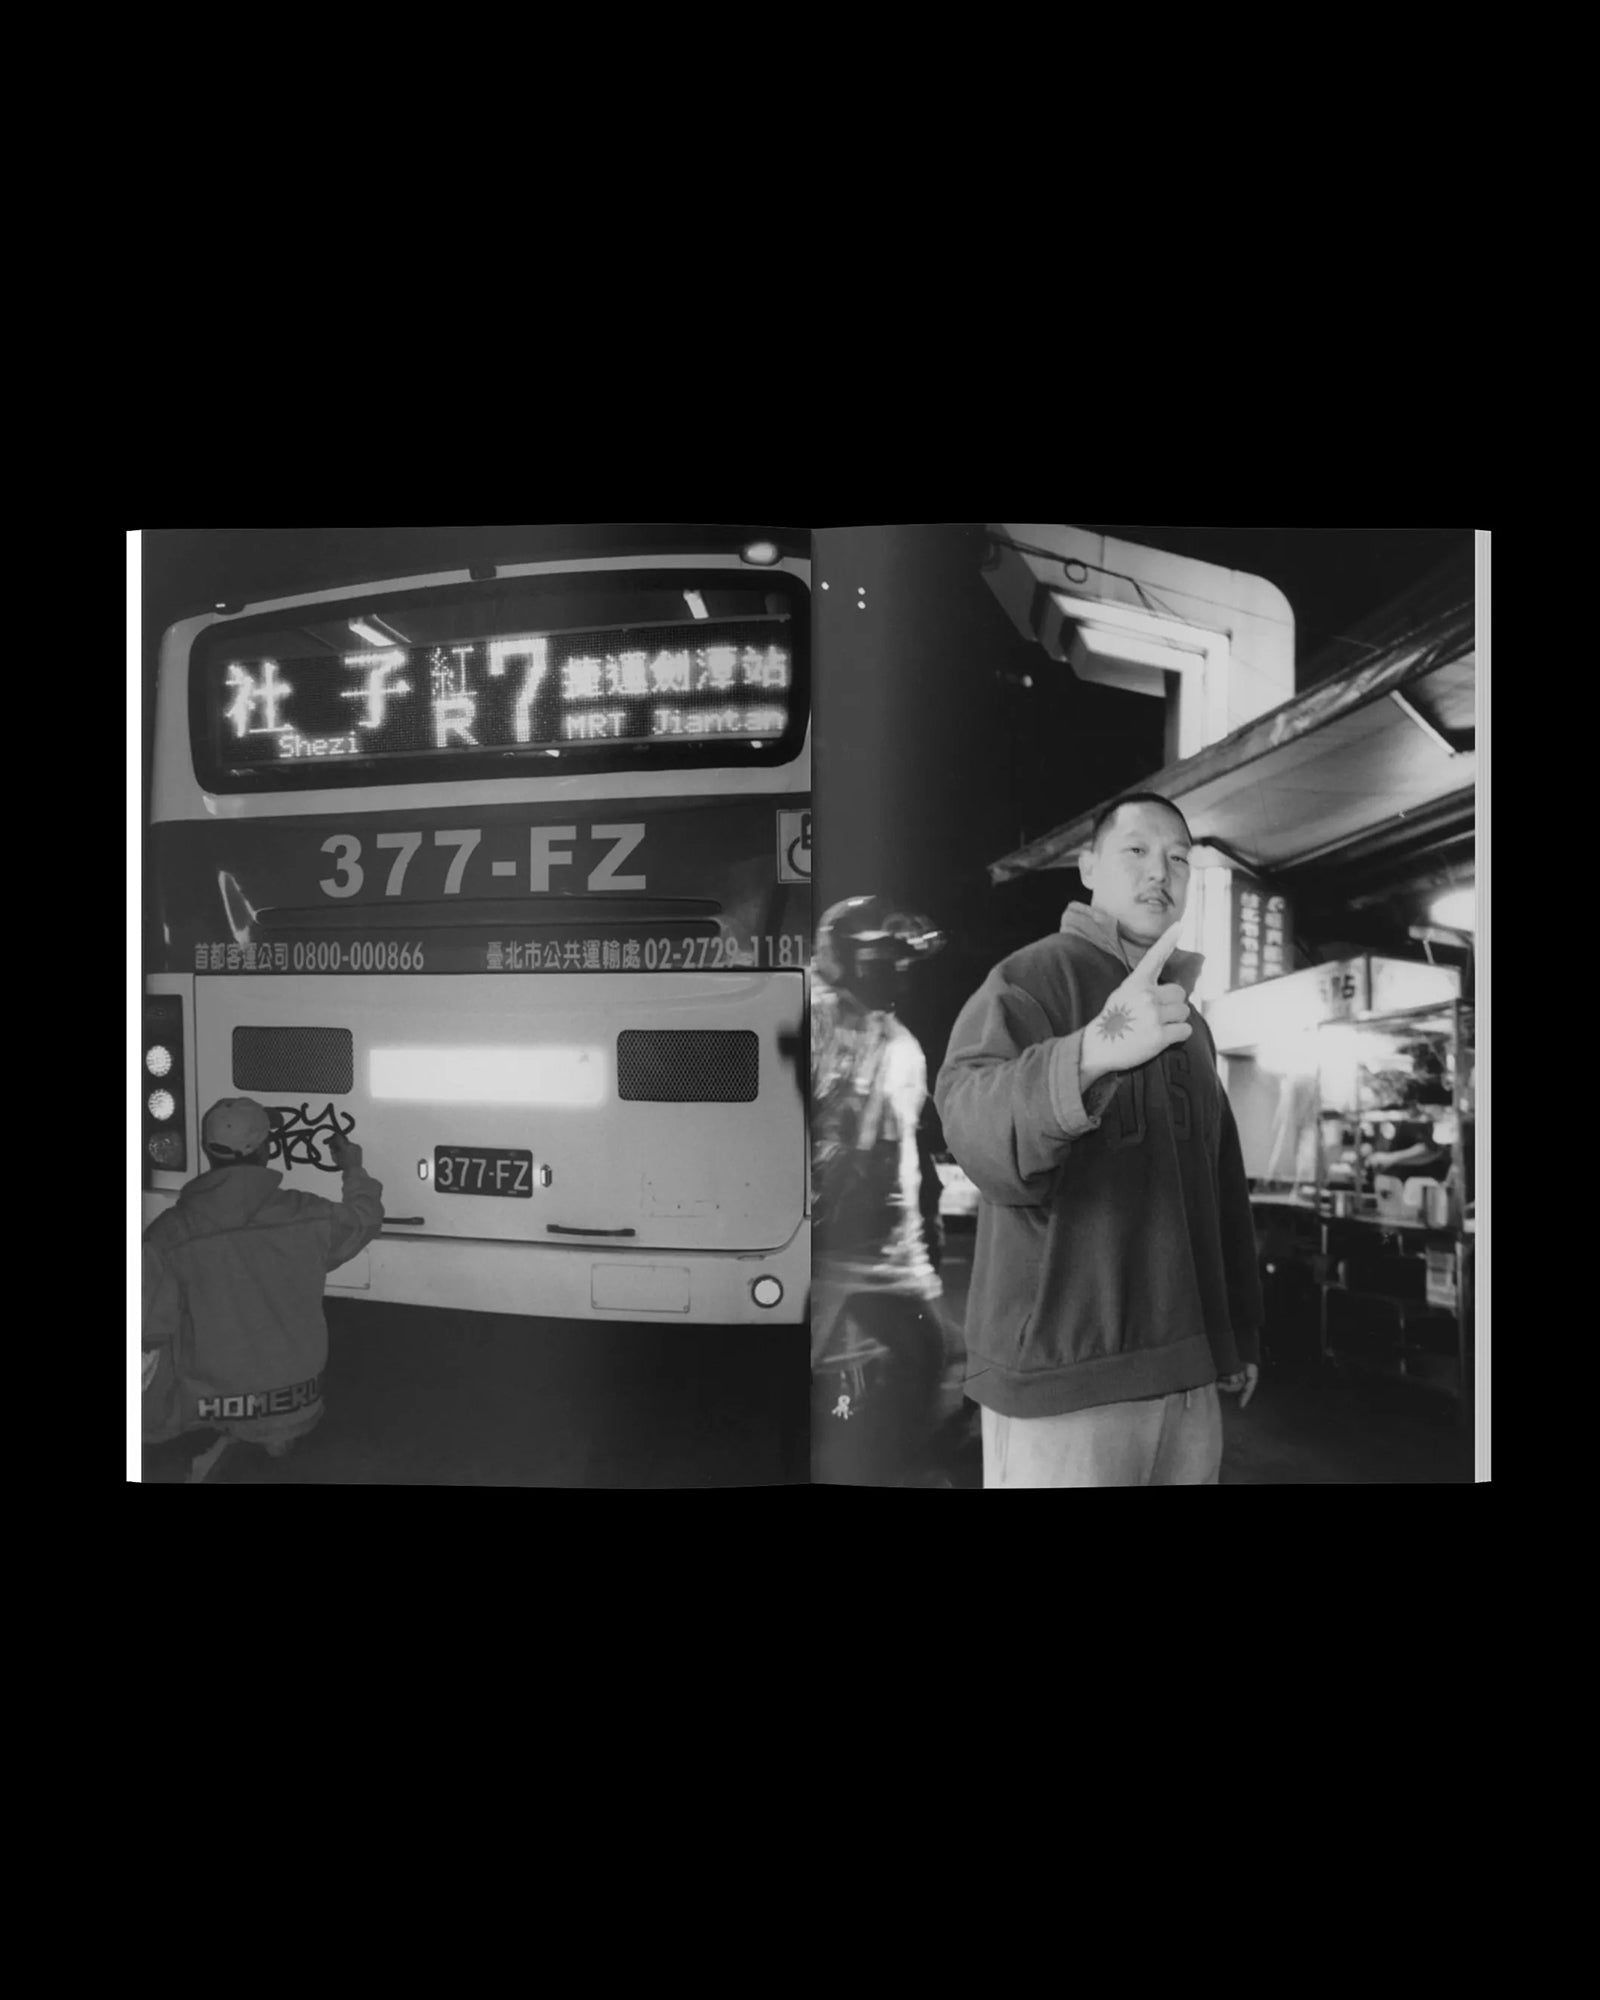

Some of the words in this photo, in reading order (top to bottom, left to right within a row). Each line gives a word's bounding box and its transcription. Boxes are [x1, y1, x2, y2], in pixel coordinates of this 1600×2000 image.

[488, 638, 548, 743] 7
[433, 699, 480, 748] R
[562, 711, 627, 740] MRT
[652, 705, 788, 736] Jiantan
[277, 731, 360, 759] Shezi
[319, 823, 647, 899] 377-FZ
[194, 942, 289, 971] 首都客運公司
[293, 941, 425, 971] 0800-000866
[644, 934, 804, 970] 02-27291181
[437, 1156, 530, 1193] 377-FZ
